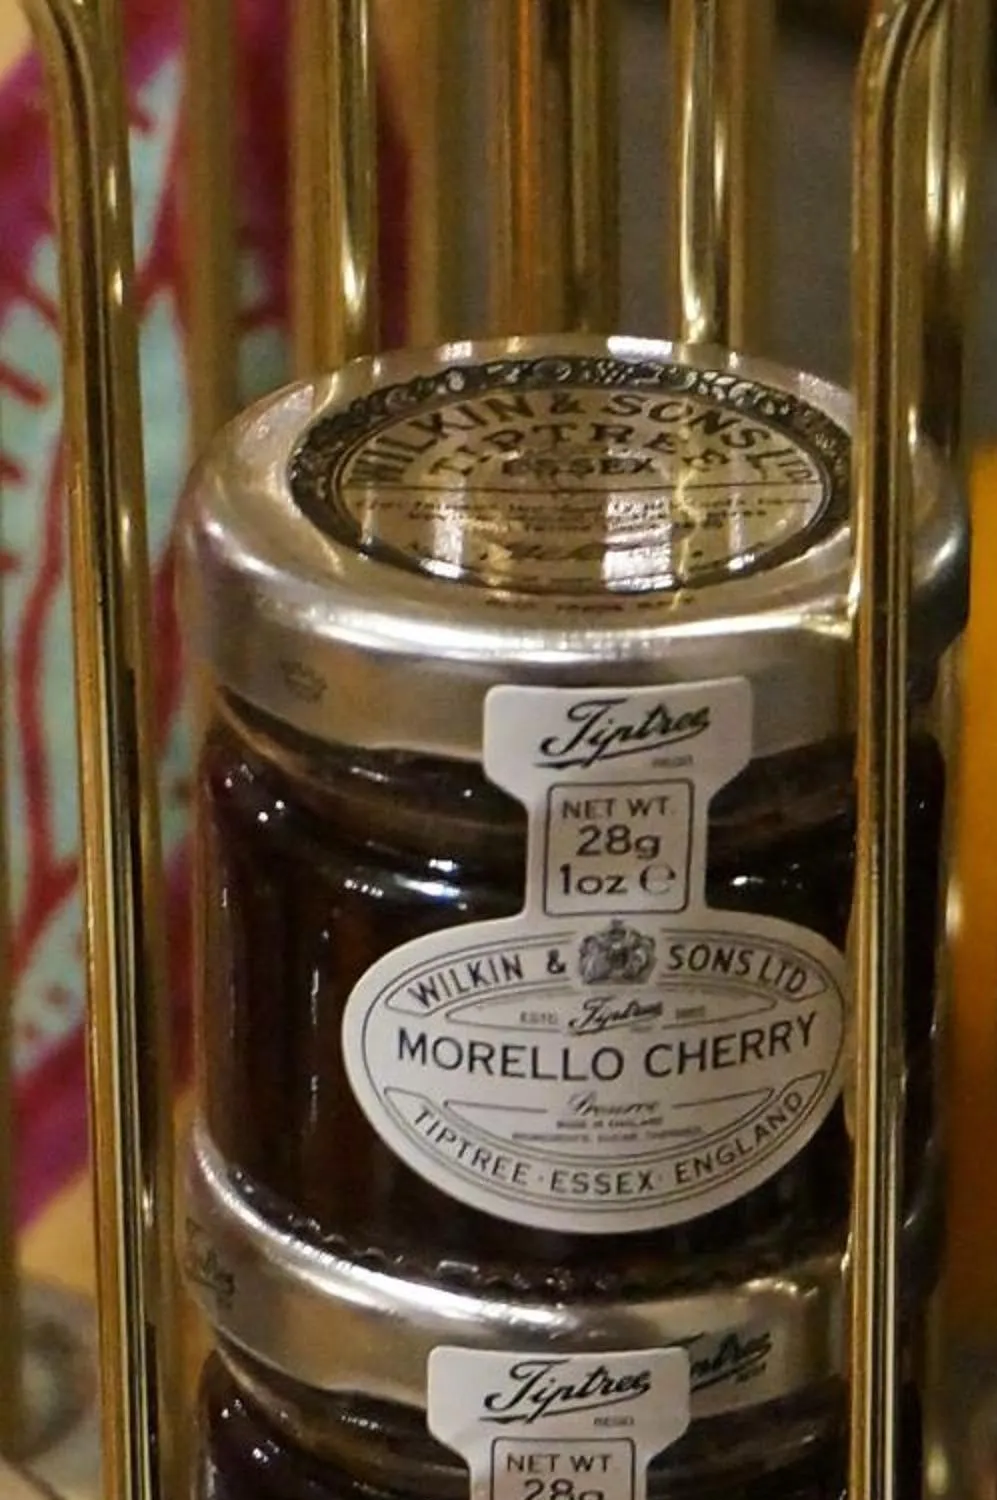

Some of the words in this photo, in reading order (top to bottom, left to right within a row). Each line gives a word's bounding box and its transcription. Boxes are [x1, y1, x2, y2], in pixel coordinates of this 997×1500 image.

[349, 393, 535, 484] WILKIN
[604, 393, 770, 450] SONS
[536, 697, 712, 768] Tiptree
[561, 800, 618, 820] NET
[577, 825, 661, 859] 28g
[560, 864, 628, 896] 1oz
[407, 953, 524, 1007] WILKIN
[546, 949, 567, 975] &
[668, 943, 753, 974] SONS
[758, 956, 808, 997] LTD
[397, 1026, 625, 1082] MORELLO
[644, 1010, 820, 1078] CHERRY
[413, 1103, 530, 1186] TIPTREE
[550, 1170, 656, 1196] ESSEX
[674, 1091, 803, 1185] ENGLAND
[481, 1359, 652, 1424] Tiptree
[506, 1453, 559, 1474] NET
